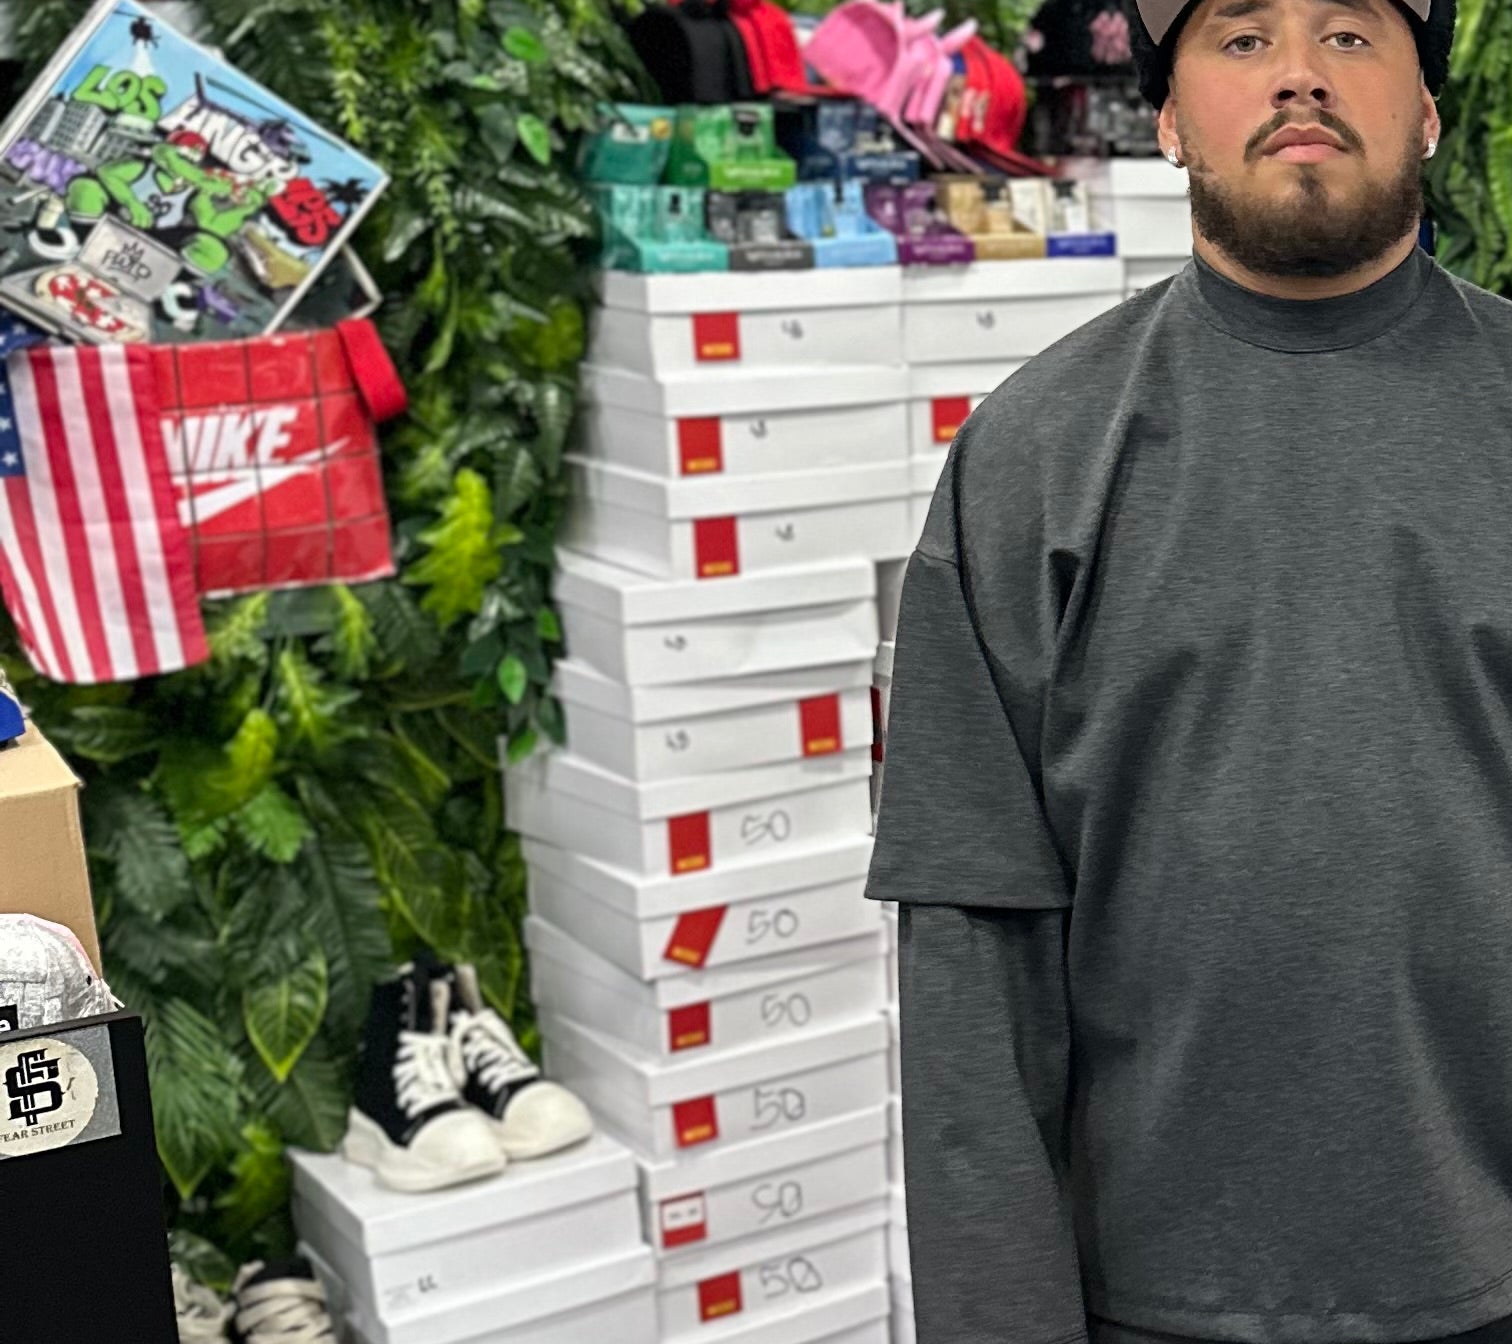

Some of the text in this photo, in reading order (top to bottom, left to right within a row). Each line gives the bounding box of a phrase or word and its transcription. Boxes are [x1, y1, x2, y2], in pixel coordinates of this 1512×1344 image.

[73, 64, 169, 122] LOS
[741, 809, 791, 846] 50
[746, 908, 799, 944] 50
[761, 992, 812, 1027] 50
[750, 1086, 806, 1131] 50
[31, 1119, 76, 1137] STREET
[759, 1257, 823, 1299] 50
